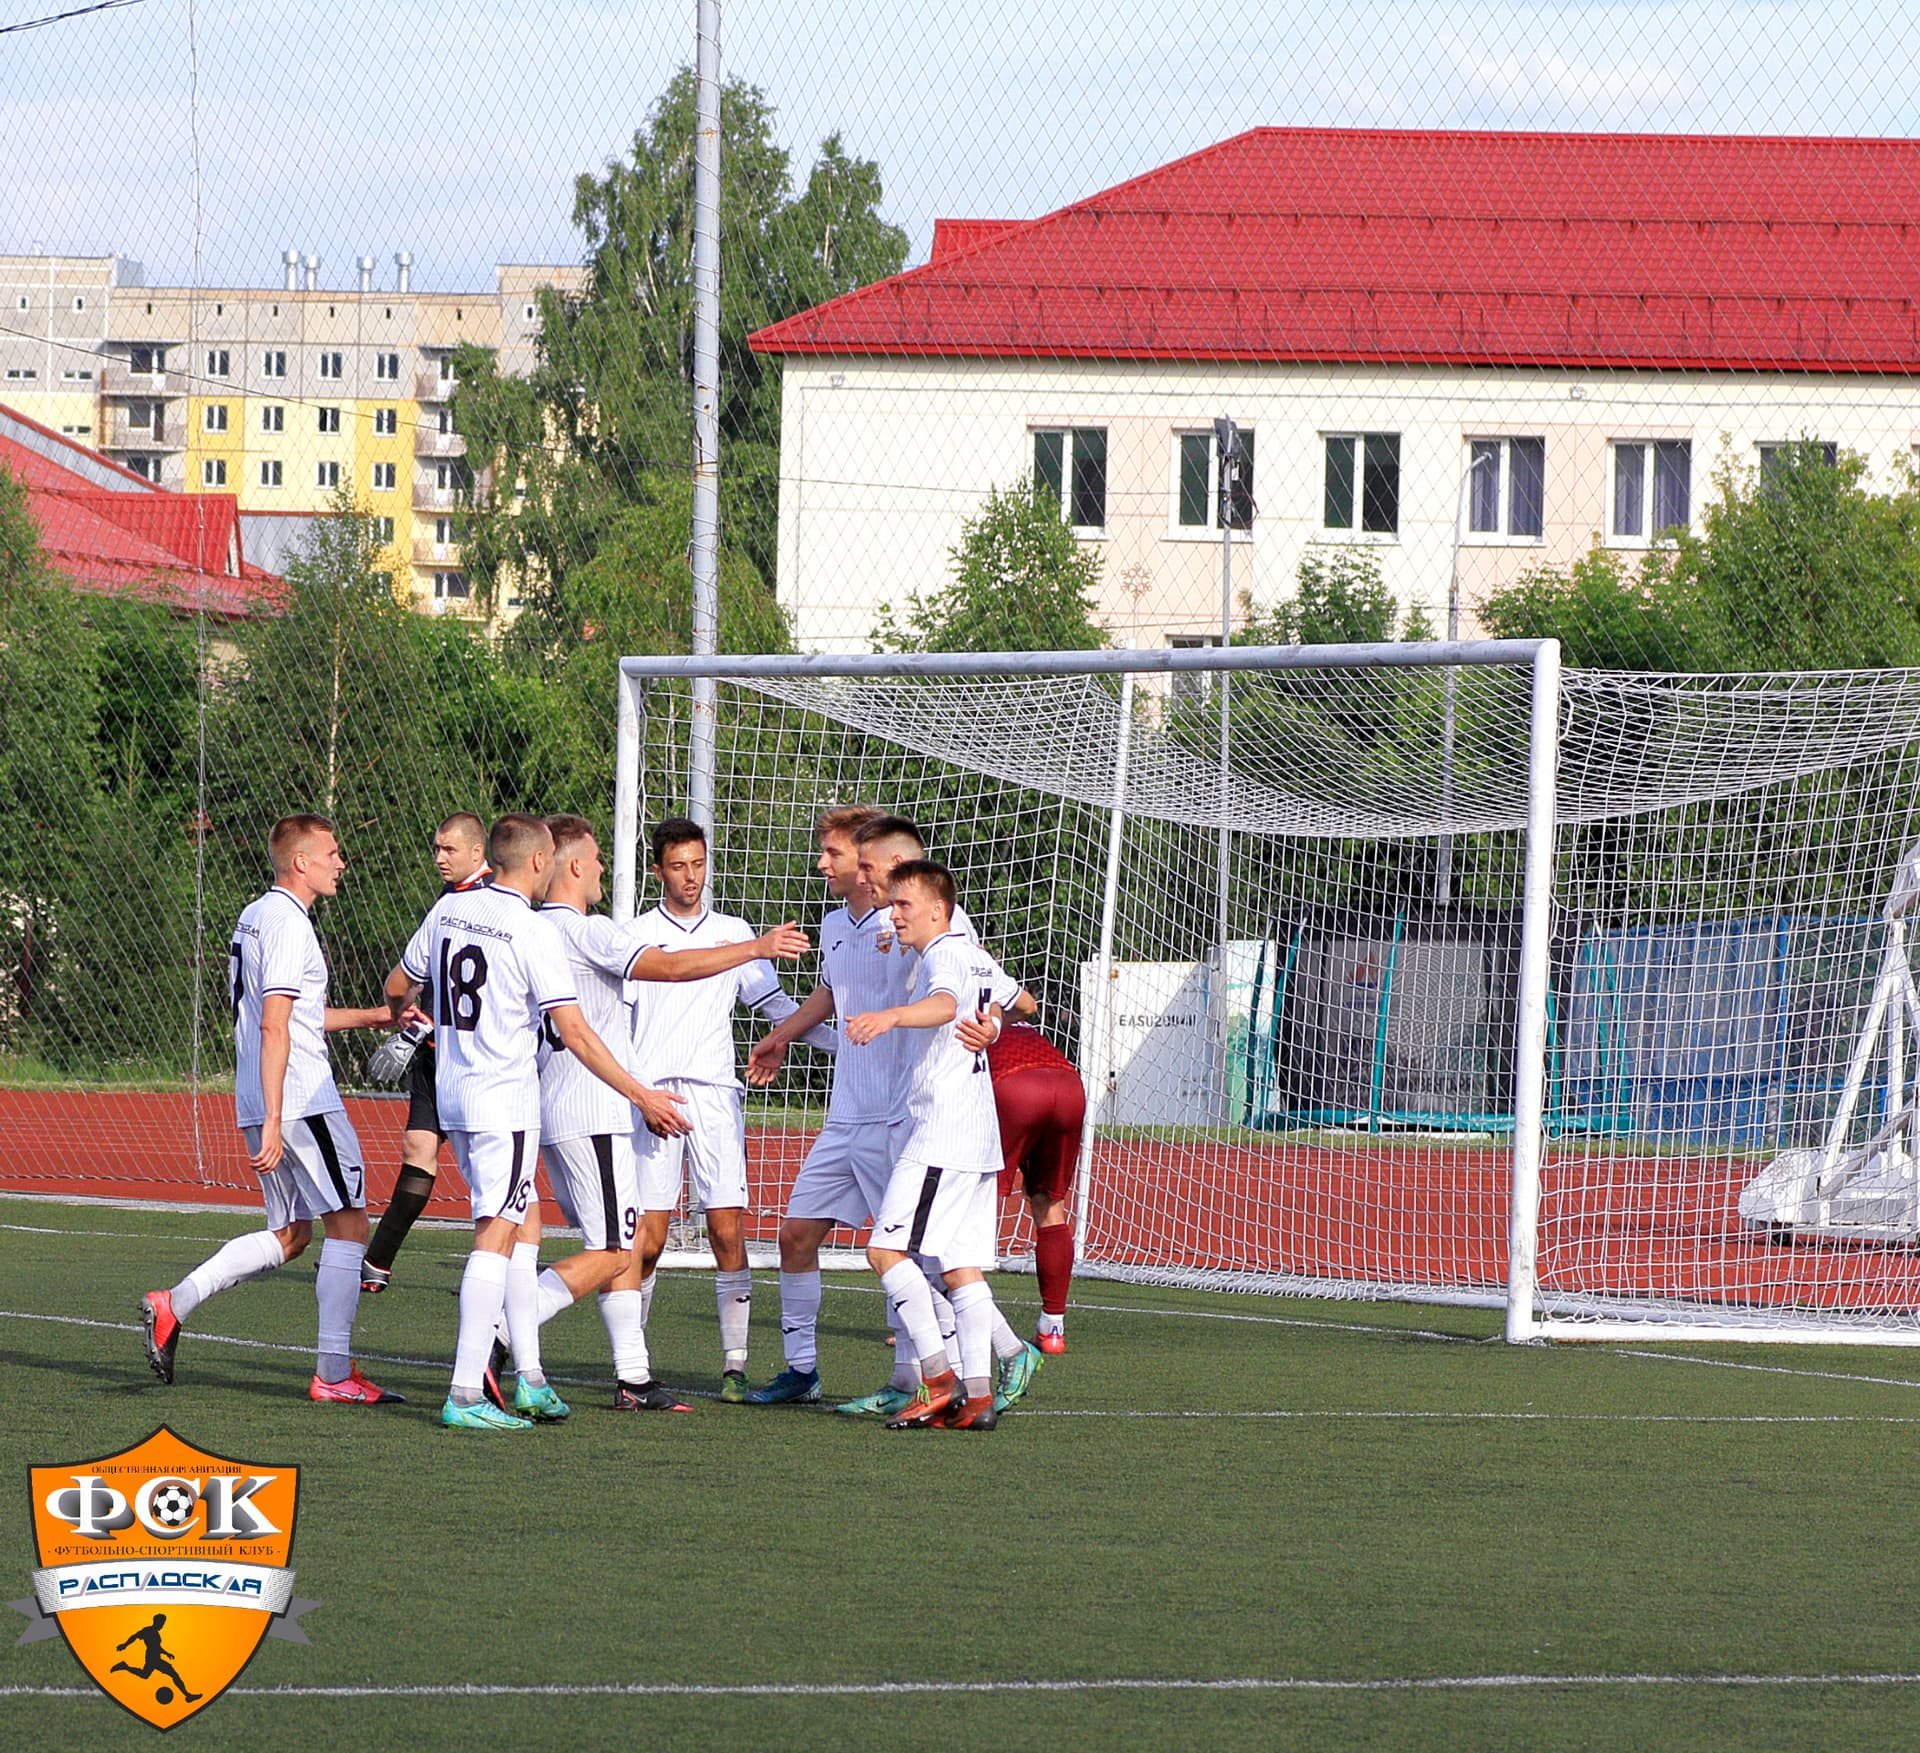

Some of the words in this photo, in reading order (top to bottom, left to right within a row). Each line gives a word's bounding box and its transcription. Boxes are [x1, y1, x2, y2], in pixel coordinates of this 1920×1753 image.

[440, 916, 513, 942] РАСПАДСКАЯ
[439, 938, 488, 1031] 18
[349, 1166, 362, 1199] 7
[507, 1178, 531, 1213] 18
[624, 1207, 637, 1240] 9
